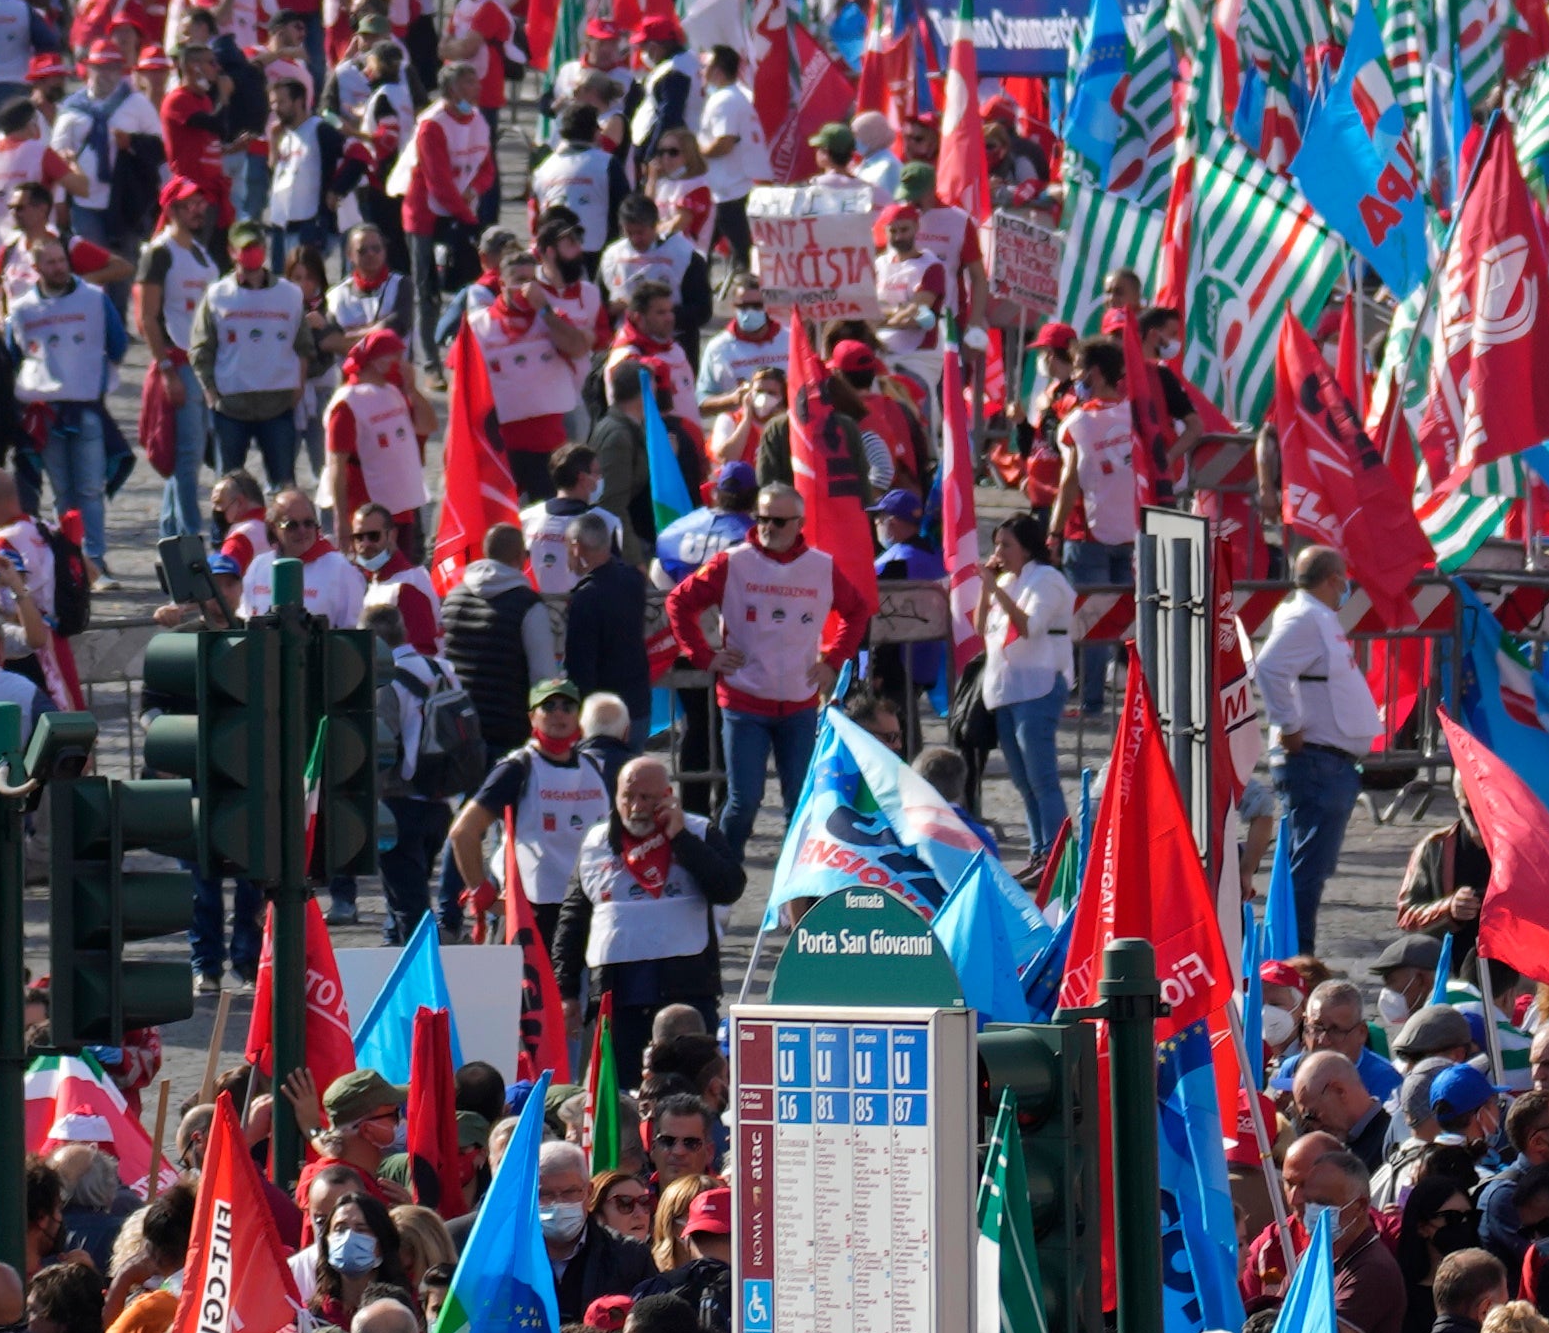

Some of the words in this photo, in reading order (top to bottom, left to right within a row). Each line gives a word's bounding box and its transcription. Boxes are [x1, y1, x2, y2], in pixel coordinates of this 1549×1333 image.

[753, 218, 819, 250] ANTI
[757, 246, 876, 289] FASCISTA
[844, 892, 885, 910] fermata
[797, 928, 838, 956] Porta
[839, 929, 869, 956] San
[869, 929, 933, 957] Giovanni
[779, 1094, 798, 1121] 16
[817, 1094, 835, 1121] 81
[855, 1096, 874, 1123] 85
[894, 1096, 913, 1123] 87
[751, 1131, 764, 1182] atac
[752, 1210, 764, 1267] ROMA
